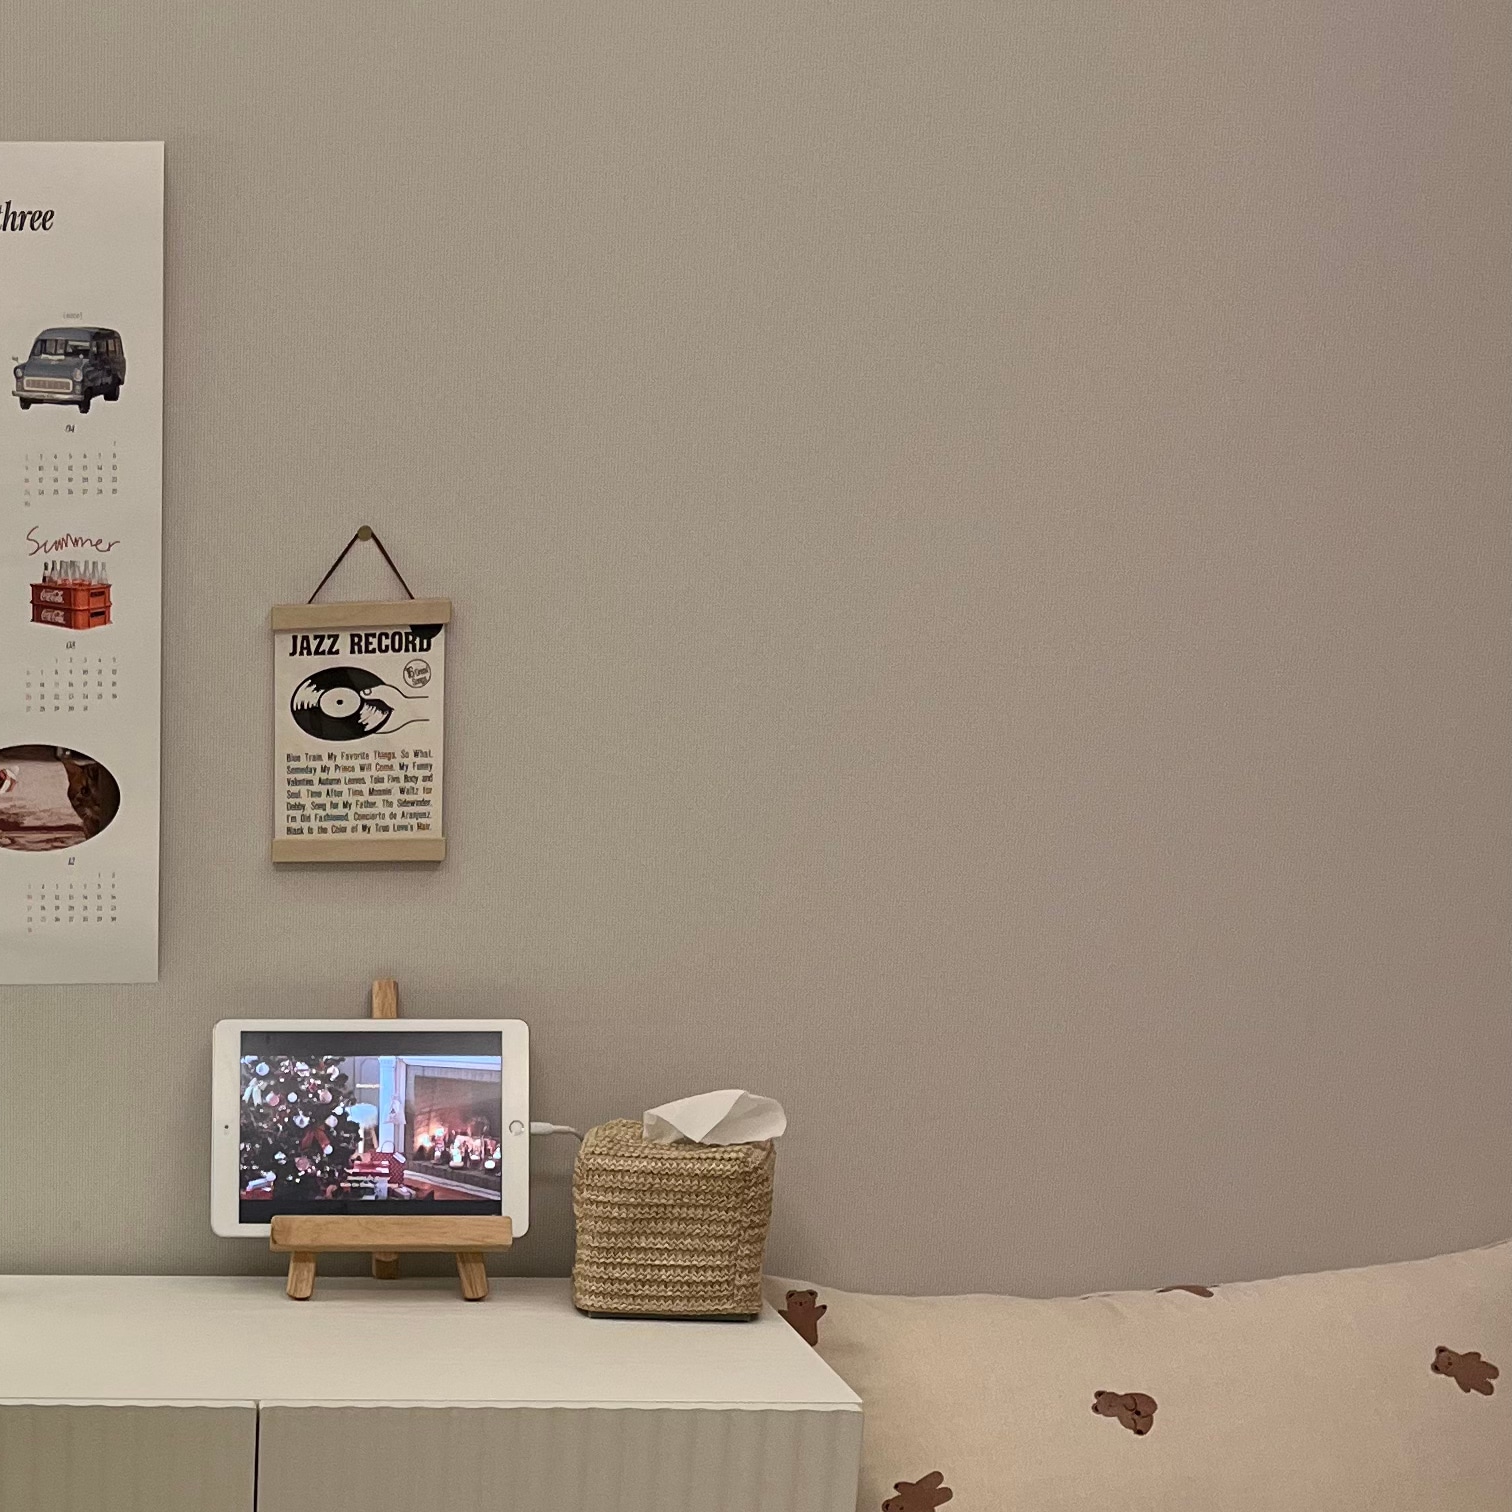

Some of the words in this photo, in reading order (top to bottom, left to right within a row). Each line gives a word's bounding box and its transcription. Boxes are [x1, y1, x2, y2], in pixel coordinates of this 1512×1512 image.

[26, 526, 120, 556] Summer
[289, 633, 340, 657] JAZZ
[349, 631, 432, 655] RECORD
[327, 752, 337, 763] My
[341, 751, 369, 761] Favorite
[400, 749, 409, 759] So
[321, 764, 331, 775] My
[399, 762, 409, 773] My
[422, 773, 433, 783] and
[326, 788, 343, 798] After
[399, 786, 419, 796] Waltz
[423, 786, 433, 795] for
[343, 800, 352, 810] My
[382, 799, 394, 808] The
[389, 811, 397, 820] de
[317, 825, 328, 834] the
[331, 824, 347, 834] Color
[351, 824, 358, 833] of
[361, 823, 371, 834] My
